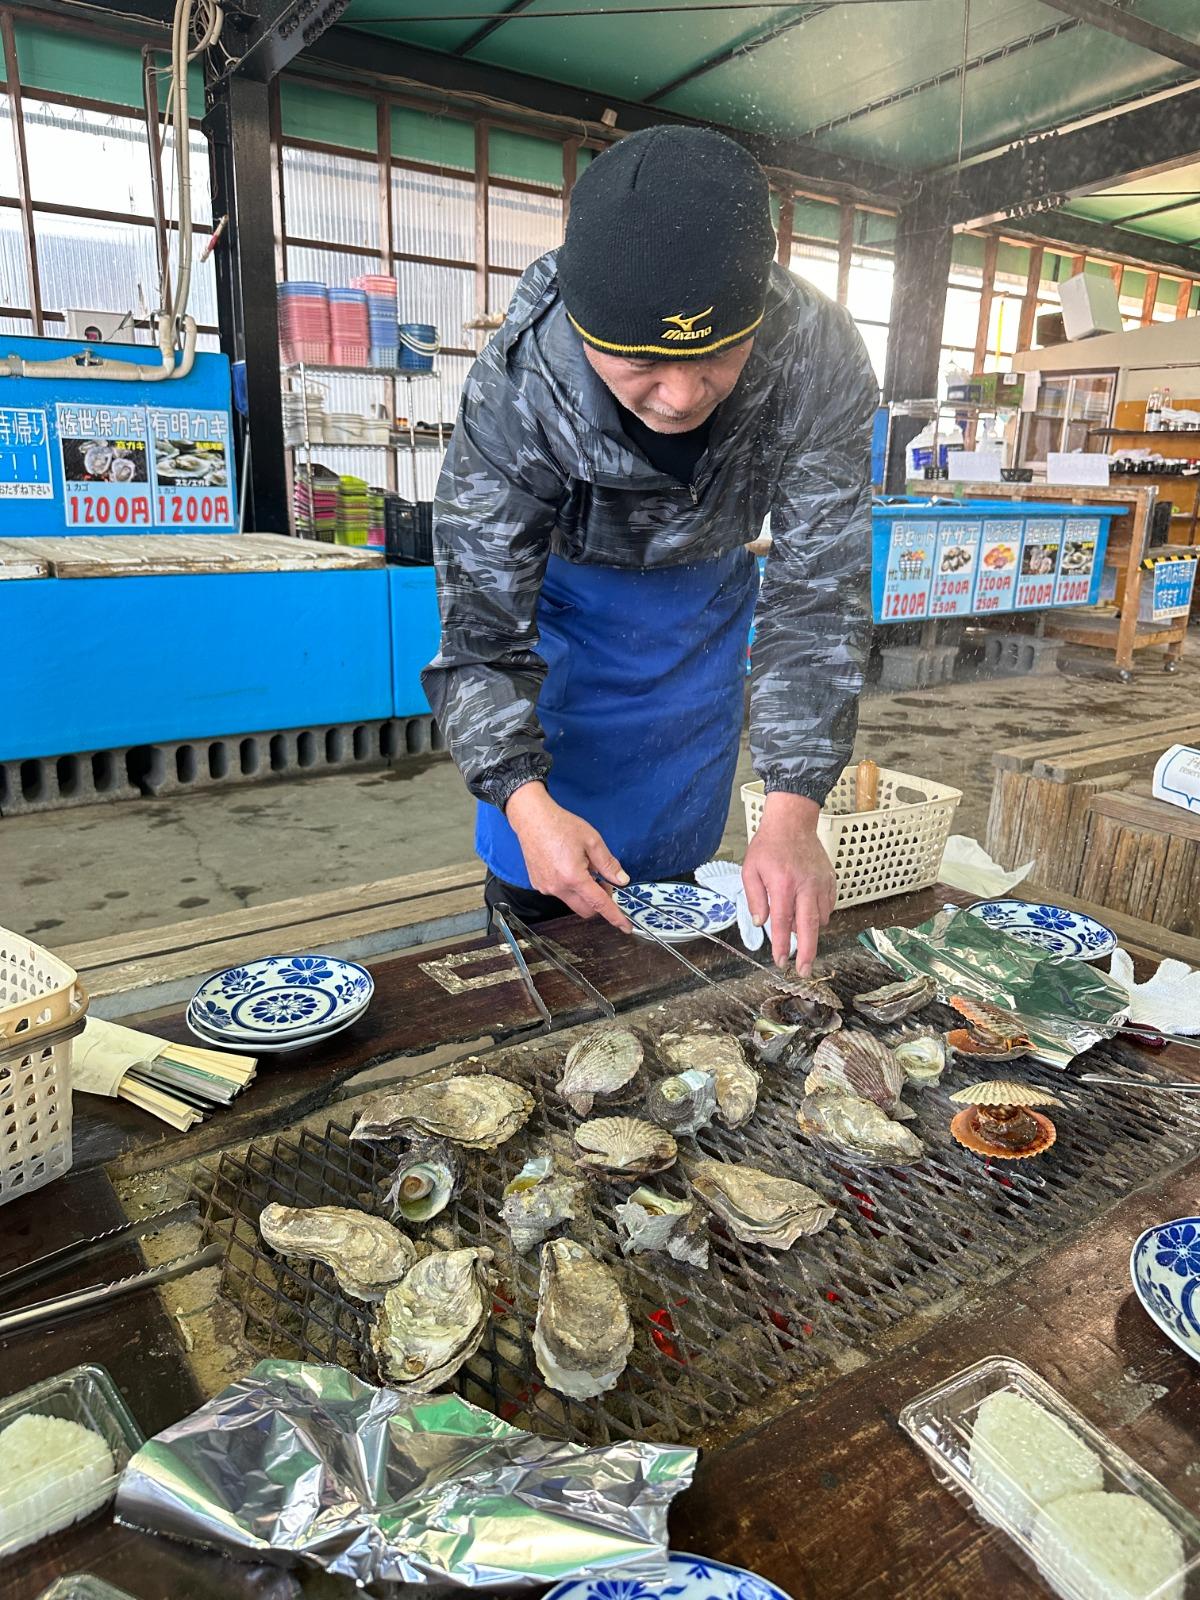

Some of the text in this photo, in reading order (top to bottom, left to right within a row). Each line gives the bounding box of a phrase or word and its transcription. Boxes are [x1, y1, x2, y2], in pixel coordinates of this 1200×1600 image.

[660, 325, 712, 340] MIZUNO
[60, 408, 146, 438] 佐世保カキ
[151, 412, 228, 440] 有明カキ
[70, 496, 150, 523] 1200円
[158, 496, 230, 523] 1200円
[934, 580, 969, 596] 1200円
[885, 592, 926, 617] 1200円
